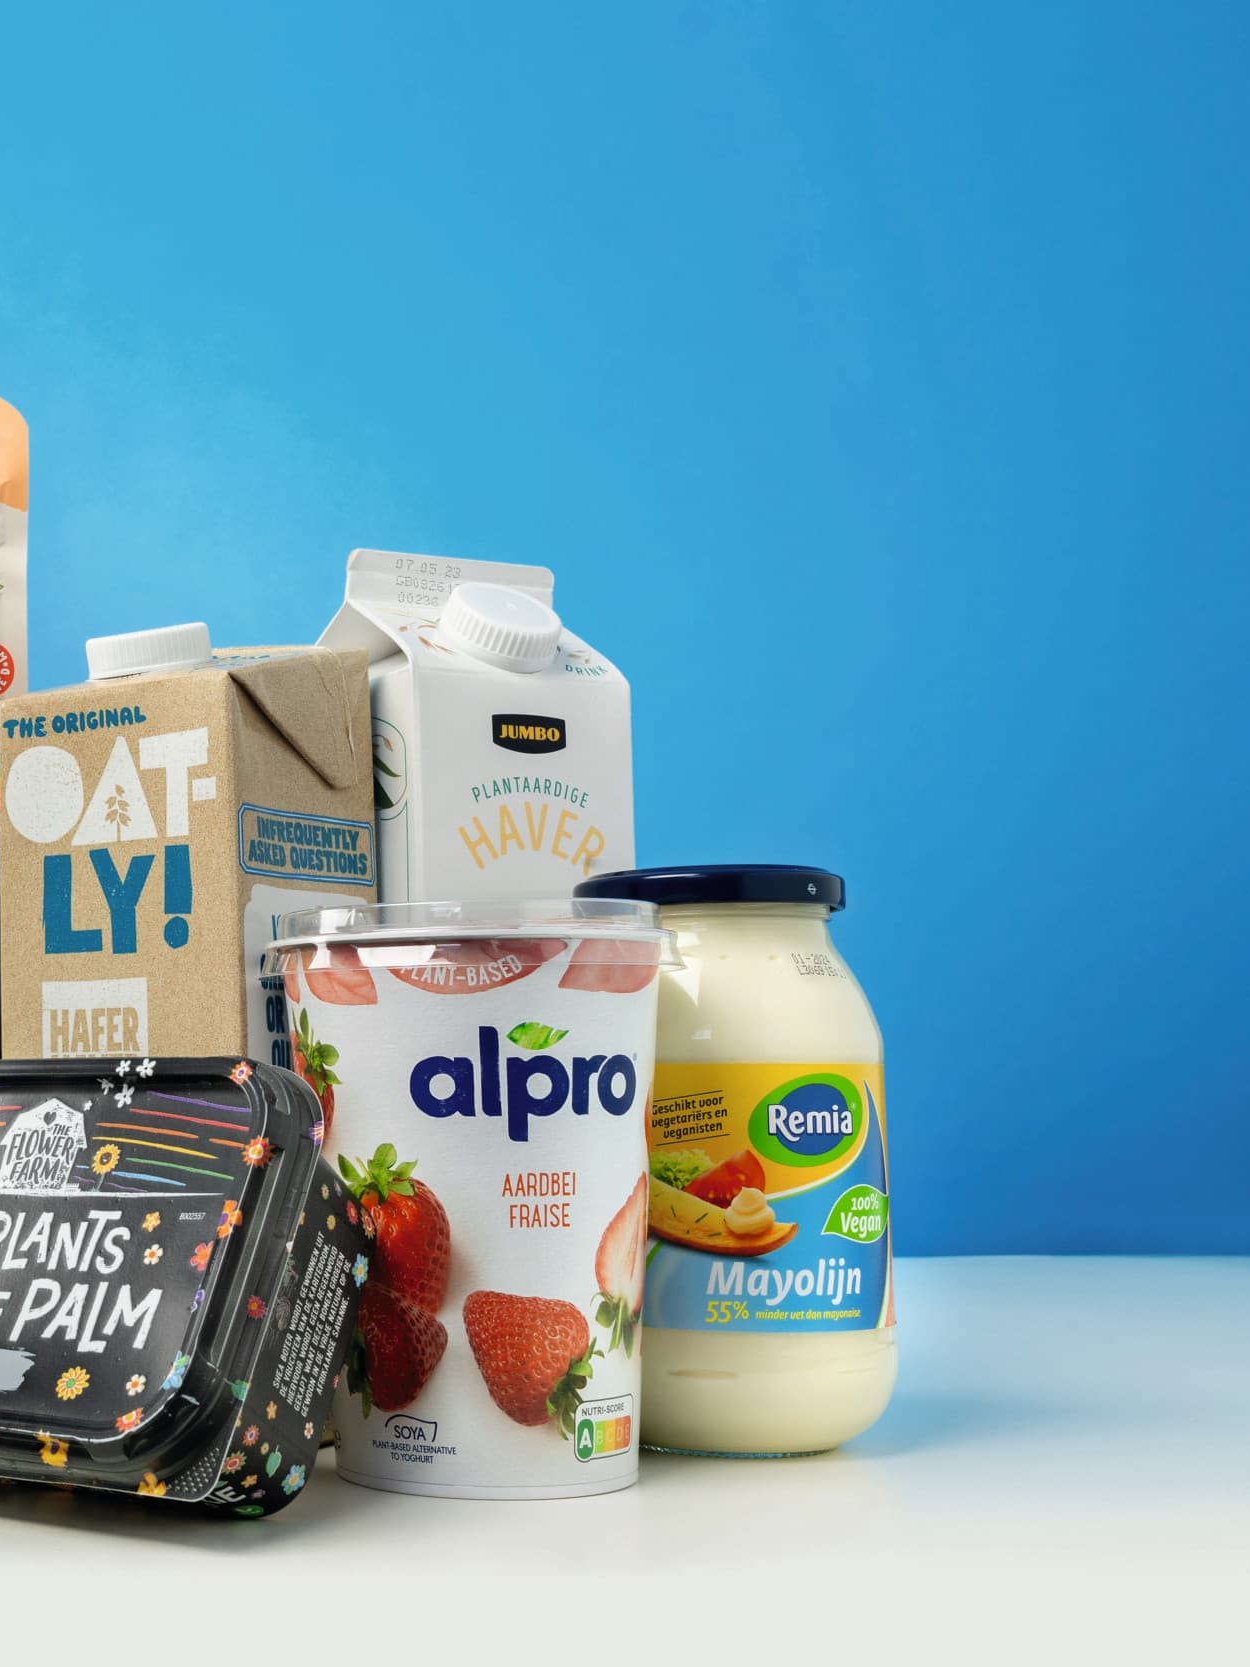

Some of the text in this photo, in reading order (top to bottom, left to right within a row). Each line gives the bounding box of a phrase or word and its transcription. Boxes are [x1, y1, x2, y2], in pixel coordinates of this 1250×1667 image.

[2, 706, 147, 739] THE ORIGINAL
[500, 723, 560, 742] JUMBO
[471, 776, 589, 808] PLANTAARDIGE
[256, 816, 360, 851] INFREQUENTLY
[458, 801, 606, 877] HAVER
[248, 839, 368, 875] ASKED QUESTIONS
[43, 844, 193, 955] LY!
[50, 1007, 140, 1053] HAFER
[409, 1025, 637, 1143] alpro
[652, 1096, 724, 1115] Geschikt voor
[652, 1108, 728, 1128] vegetariërs en
[53, 1123, 72, 1135] THE
[663, 1122, 723, 1140] veganisten
[767, 1103, 854, 1142] Remia
[6, 1129, 75, 1166] FLOWER
[10, 1156, 61, 1185] FARM
[501, 1172, 578, 1198] AARDBEI
[509, 1202, 571, 1228] FRAISE
[851, 1192, 880, 1212] 100%
[840, 1211, 882, 1237] Vegan
[706, 1258, 862, 1306] Mayolijn
[9, 1279, 163, 1353] PALM
[272, 1231, 325, 1389] SHEA BOTER WORDT GEWONNEN UIT
[304, 1299, 312, 1314] DE
[327, 1286, 343, 1323] NATUUR
[705, 1301, 750, 1324] 55%
[755, 1309, 788, 1320] minder
[806, 1309, 822, 1320] dan
[286, 1245, 338, 1405] HIERVOOR WORDT GEEN REGENWOUD
[293, 1251, 346, 1412] GEKAPT WANT DEZE BOMEN GROEIEN
[297, 1312, 308, 1332] VAN
[319, 1322, 332, 1349] VRIJE
[283, 1333, 302, 1382] VRUCHTEN
[312, 1364, 320, 1377] IN
[315, 1350, 324, 1365] DE
[316, 1338, 337, 1396] AFRIKAANSE
[279, 1383, 288, 1398] DE
[301, 1377, 317, 1418] GEWOON
[581, 1402, 625, 1416] NUTRI-SCORE
[393, 1424, 427, 1441] SOYA
[579, 1427, 592, 1449] A
[372, 1440, 457, 1455] PLANT-BASED ALTERNATIVE
[390, 1451, 434, 1464] TO YOGHURT
